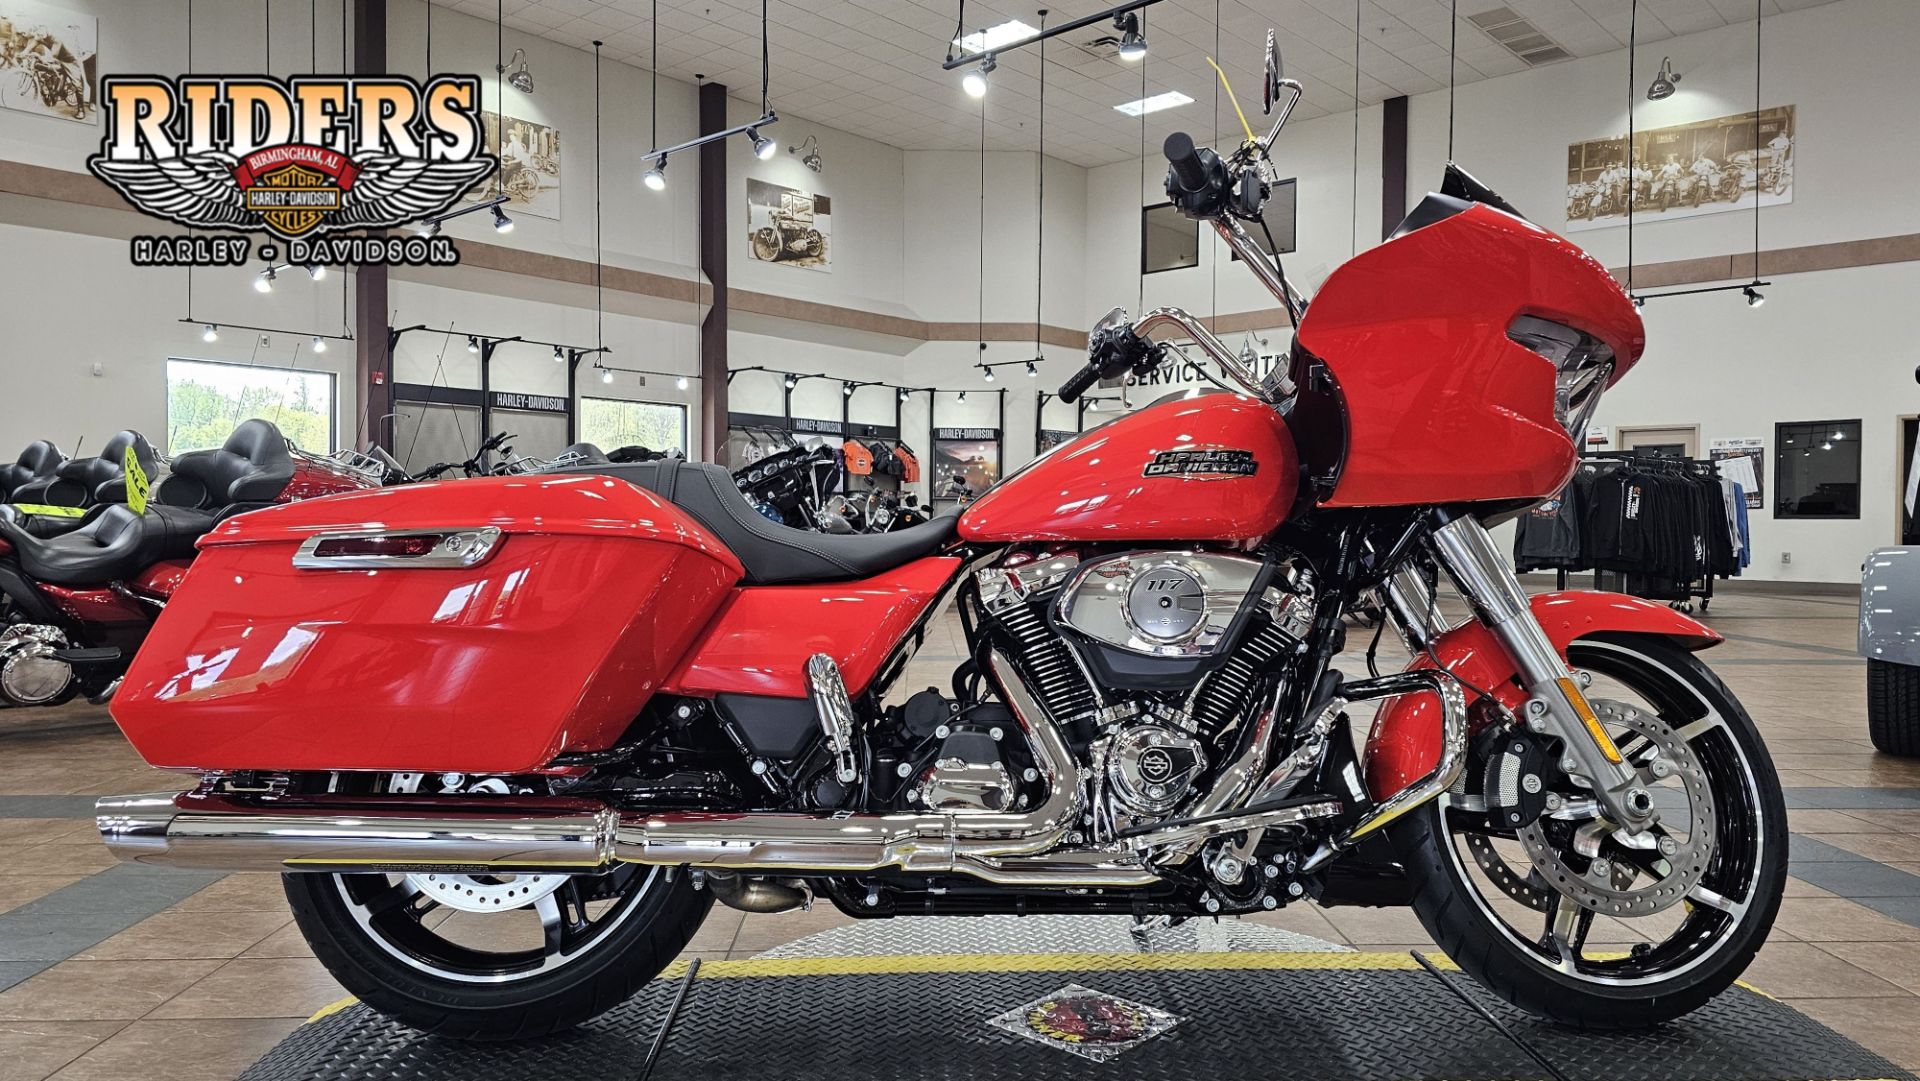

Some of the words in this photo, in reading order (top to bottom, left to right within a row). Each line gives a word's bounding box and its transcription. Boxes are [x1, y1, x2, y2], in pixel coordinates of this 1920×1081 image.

[497, 393, 565, 411] HARLEY-DAVIDSON
[796, 419, 842, 433] HARLEY-DAVIDSON
[939, 428, 995, 439] HARLEY-DAVIDSON
[1146, 579, 1184, 592] 117
